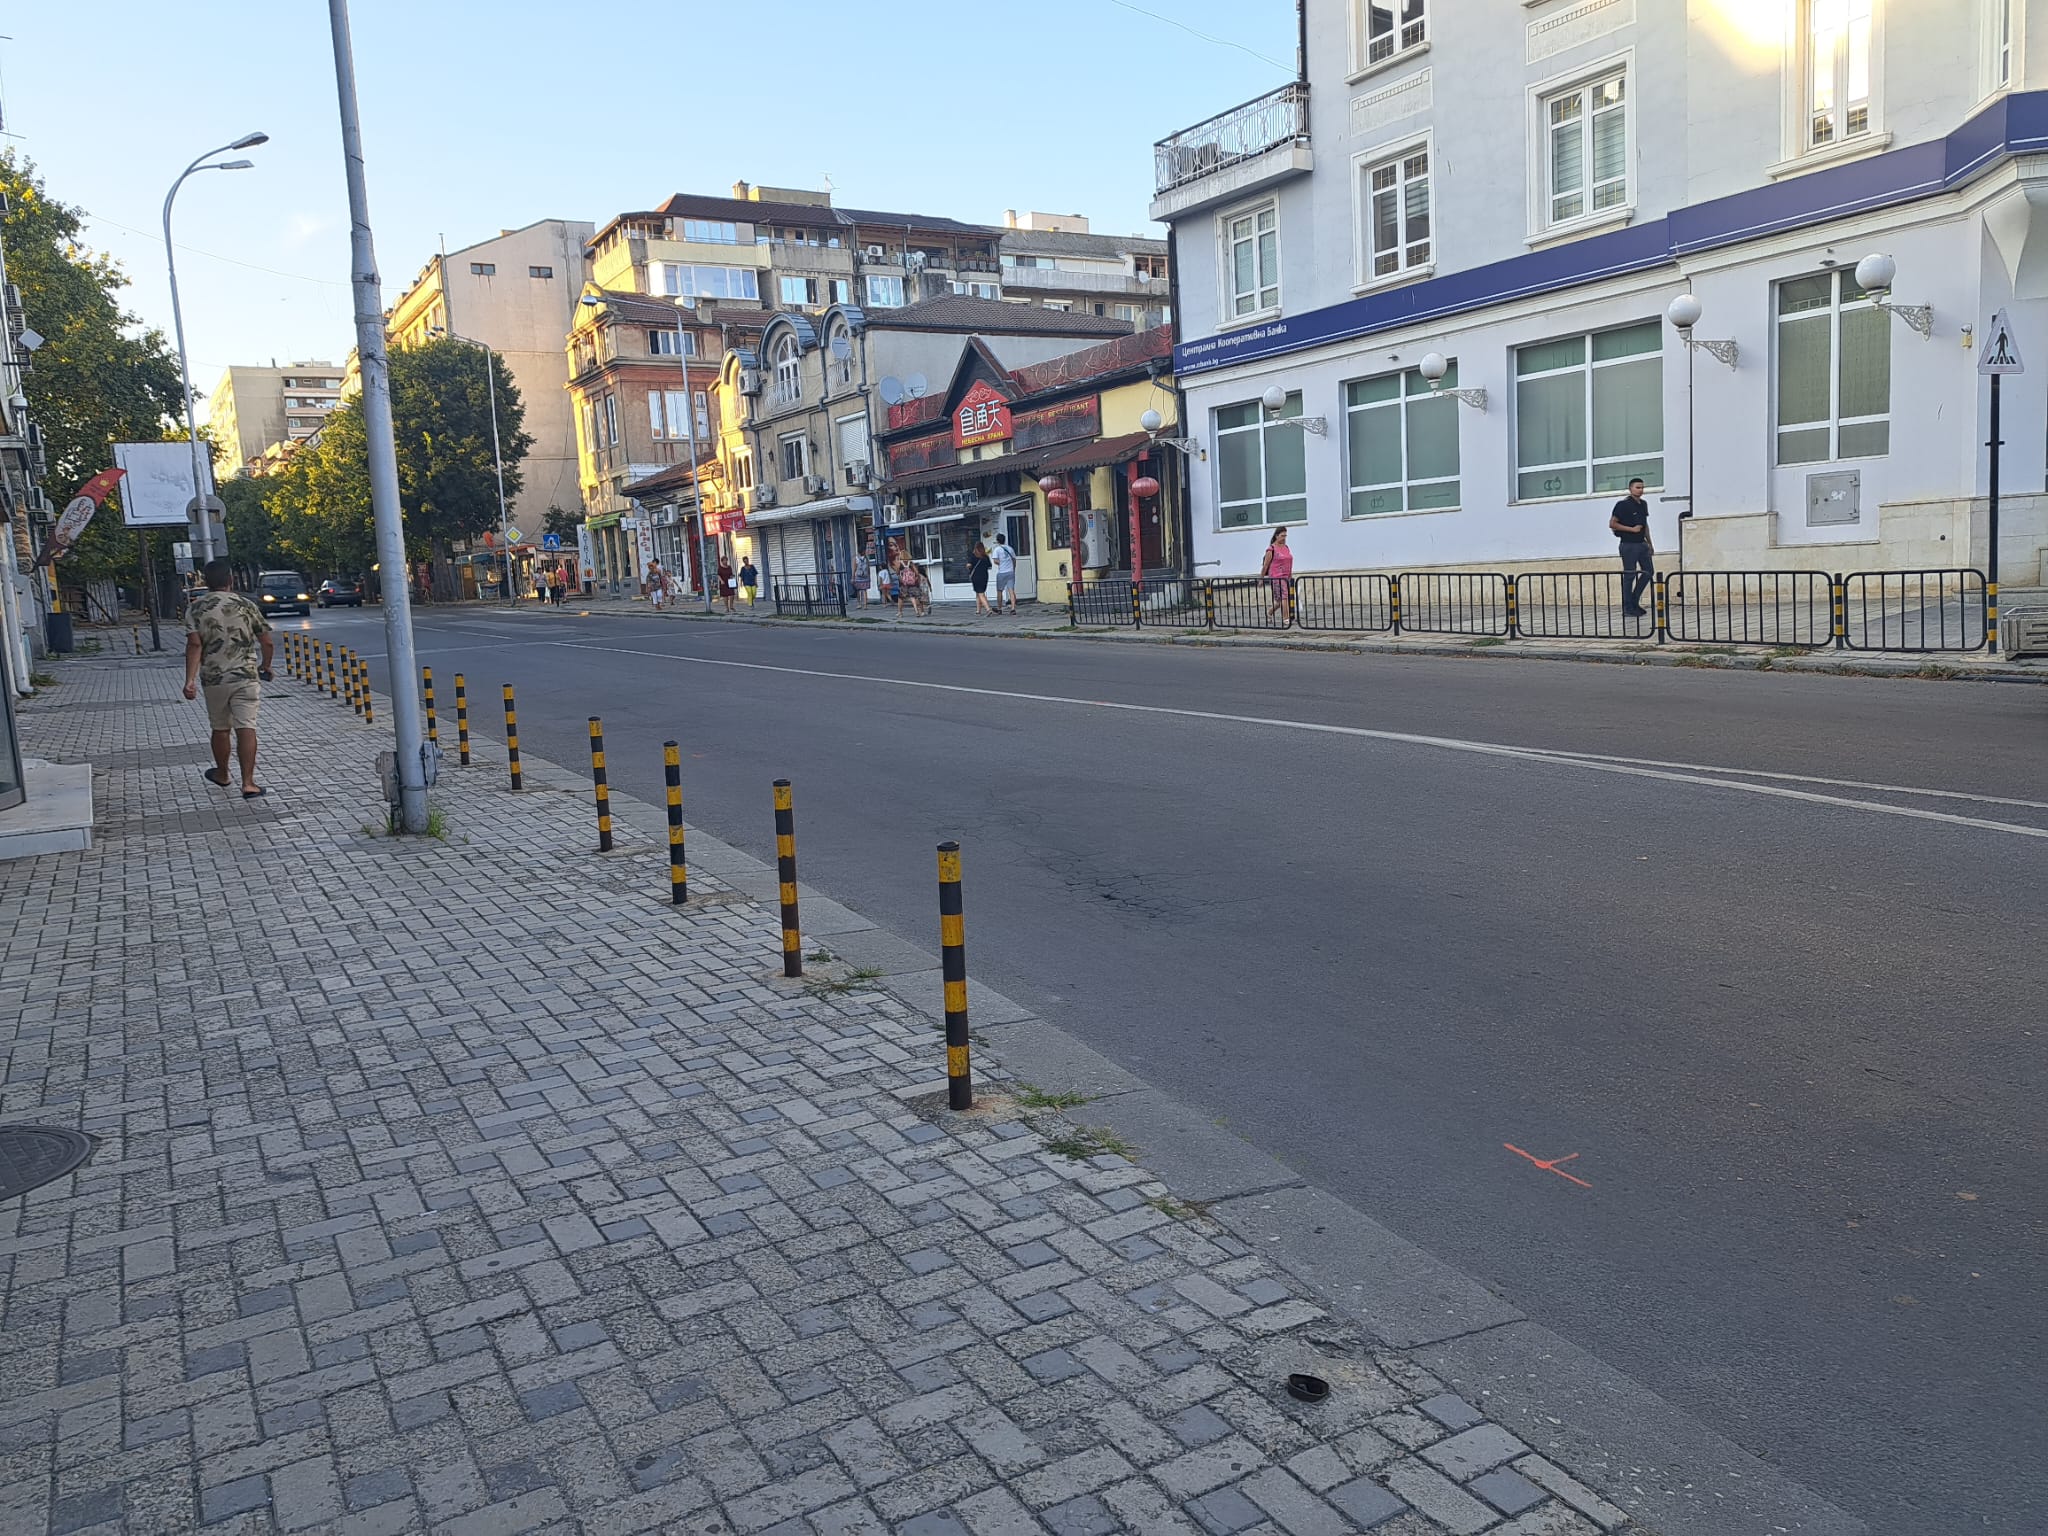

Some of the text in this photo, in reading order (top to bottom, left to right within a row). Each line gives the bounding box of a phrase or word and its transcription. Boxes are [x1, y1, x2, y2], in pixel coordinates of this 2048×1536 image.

[1182, 323, 1287, 357] Централна Кооперативна Банка
